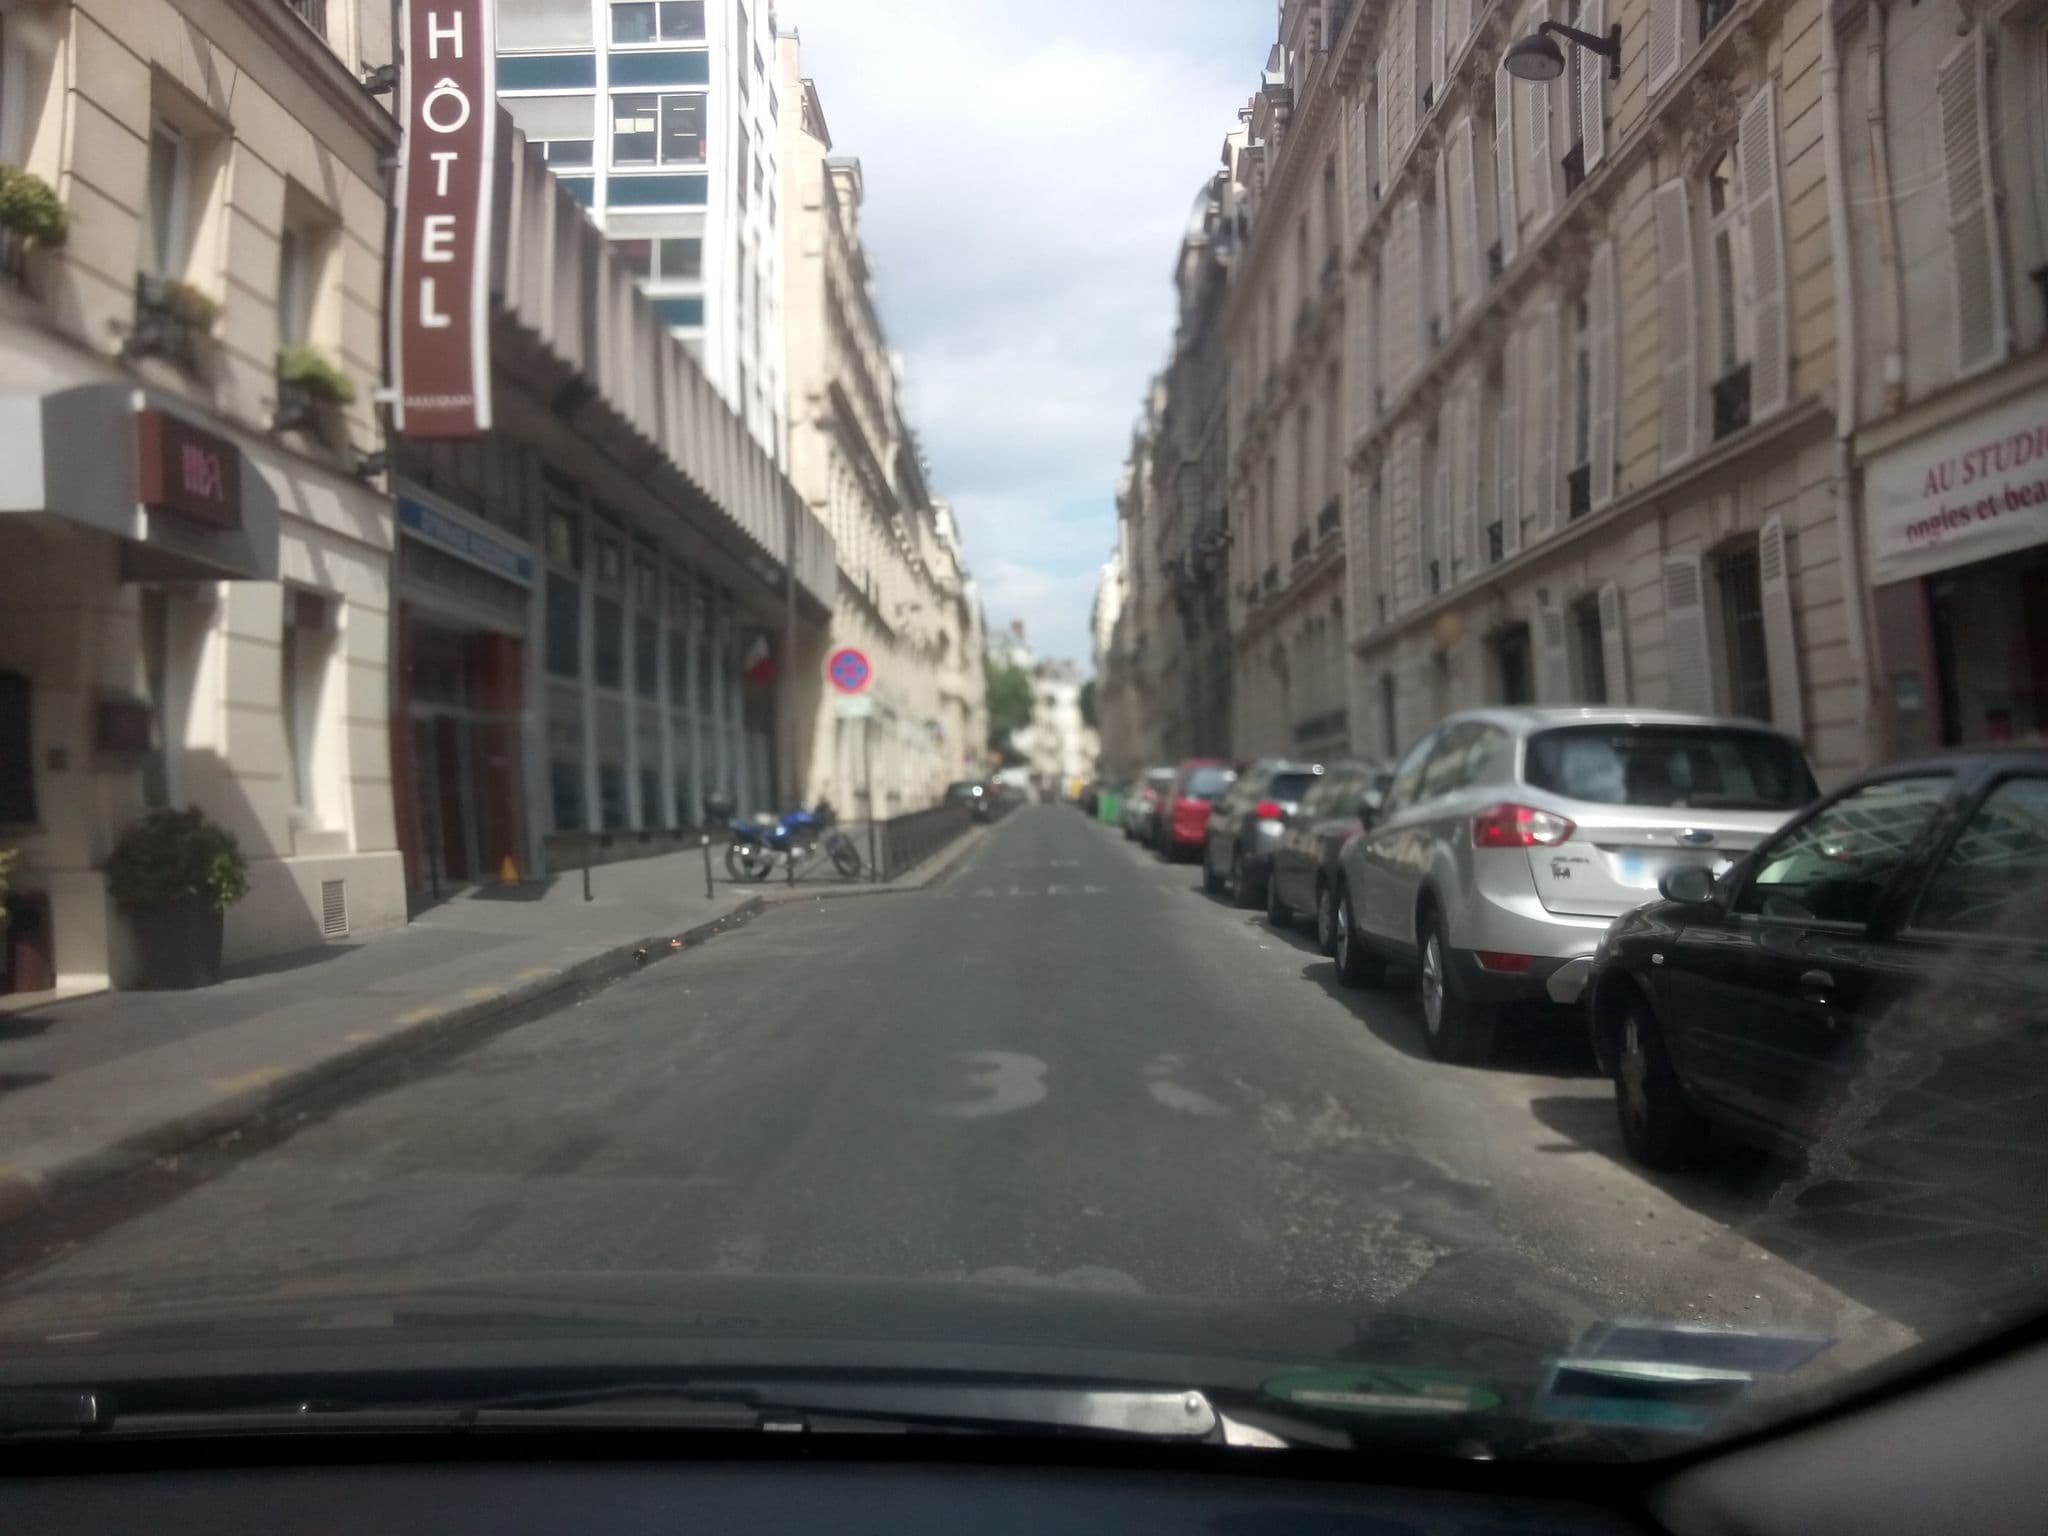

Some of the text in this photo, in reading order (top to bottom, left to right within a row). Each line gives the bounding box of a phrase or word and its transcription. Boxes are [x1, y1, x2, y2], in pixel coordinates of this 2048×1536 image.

[419, 10, 471, 328] HÔTEL
[1922, 457, 1956, 498] AU
[2004, 479, 2048, 512] bea
